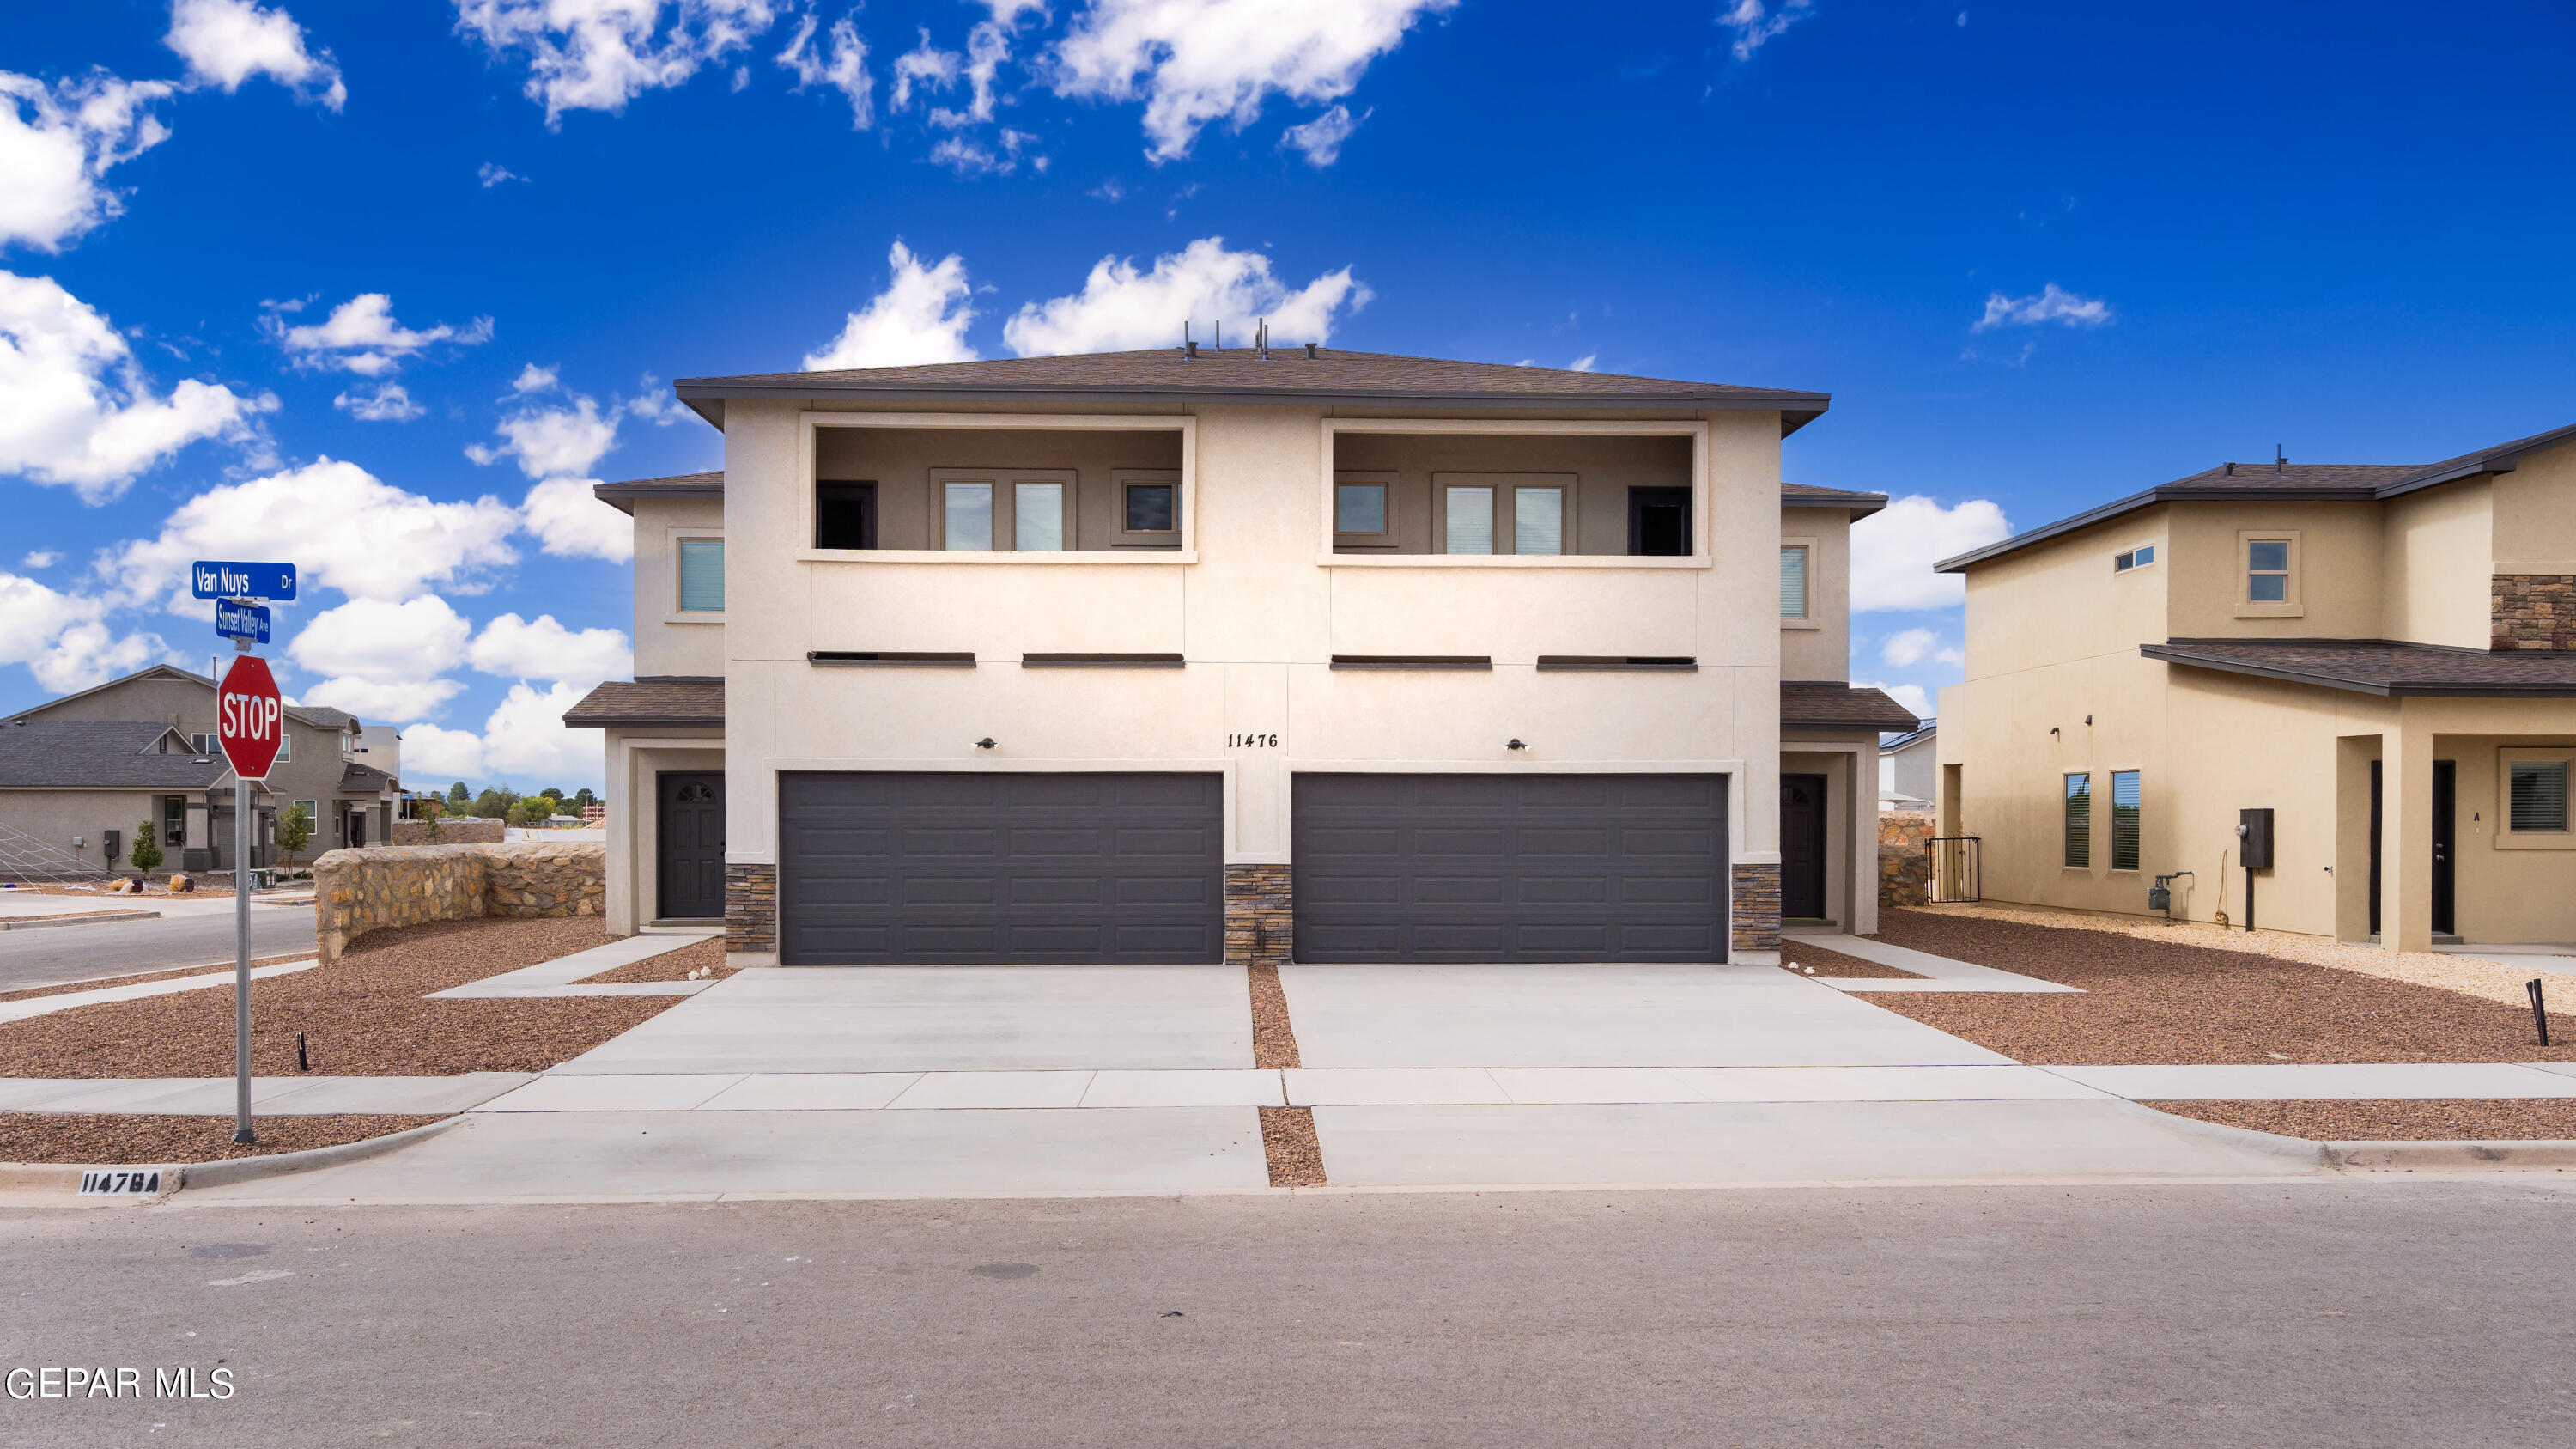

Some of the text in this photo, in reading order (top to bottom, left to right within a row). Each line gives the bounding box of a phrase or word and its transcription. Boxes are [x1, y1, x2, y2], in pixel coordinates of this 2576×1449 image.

[197, 567, 292, 597] Van Nuys Dr
[218, 604, 269, 639] Sunset Valley Ave
[223, 691, 278, 740] STOP
[1228, 734, 1278, 747] 11476
[2474, 812, 2480, 821] A
